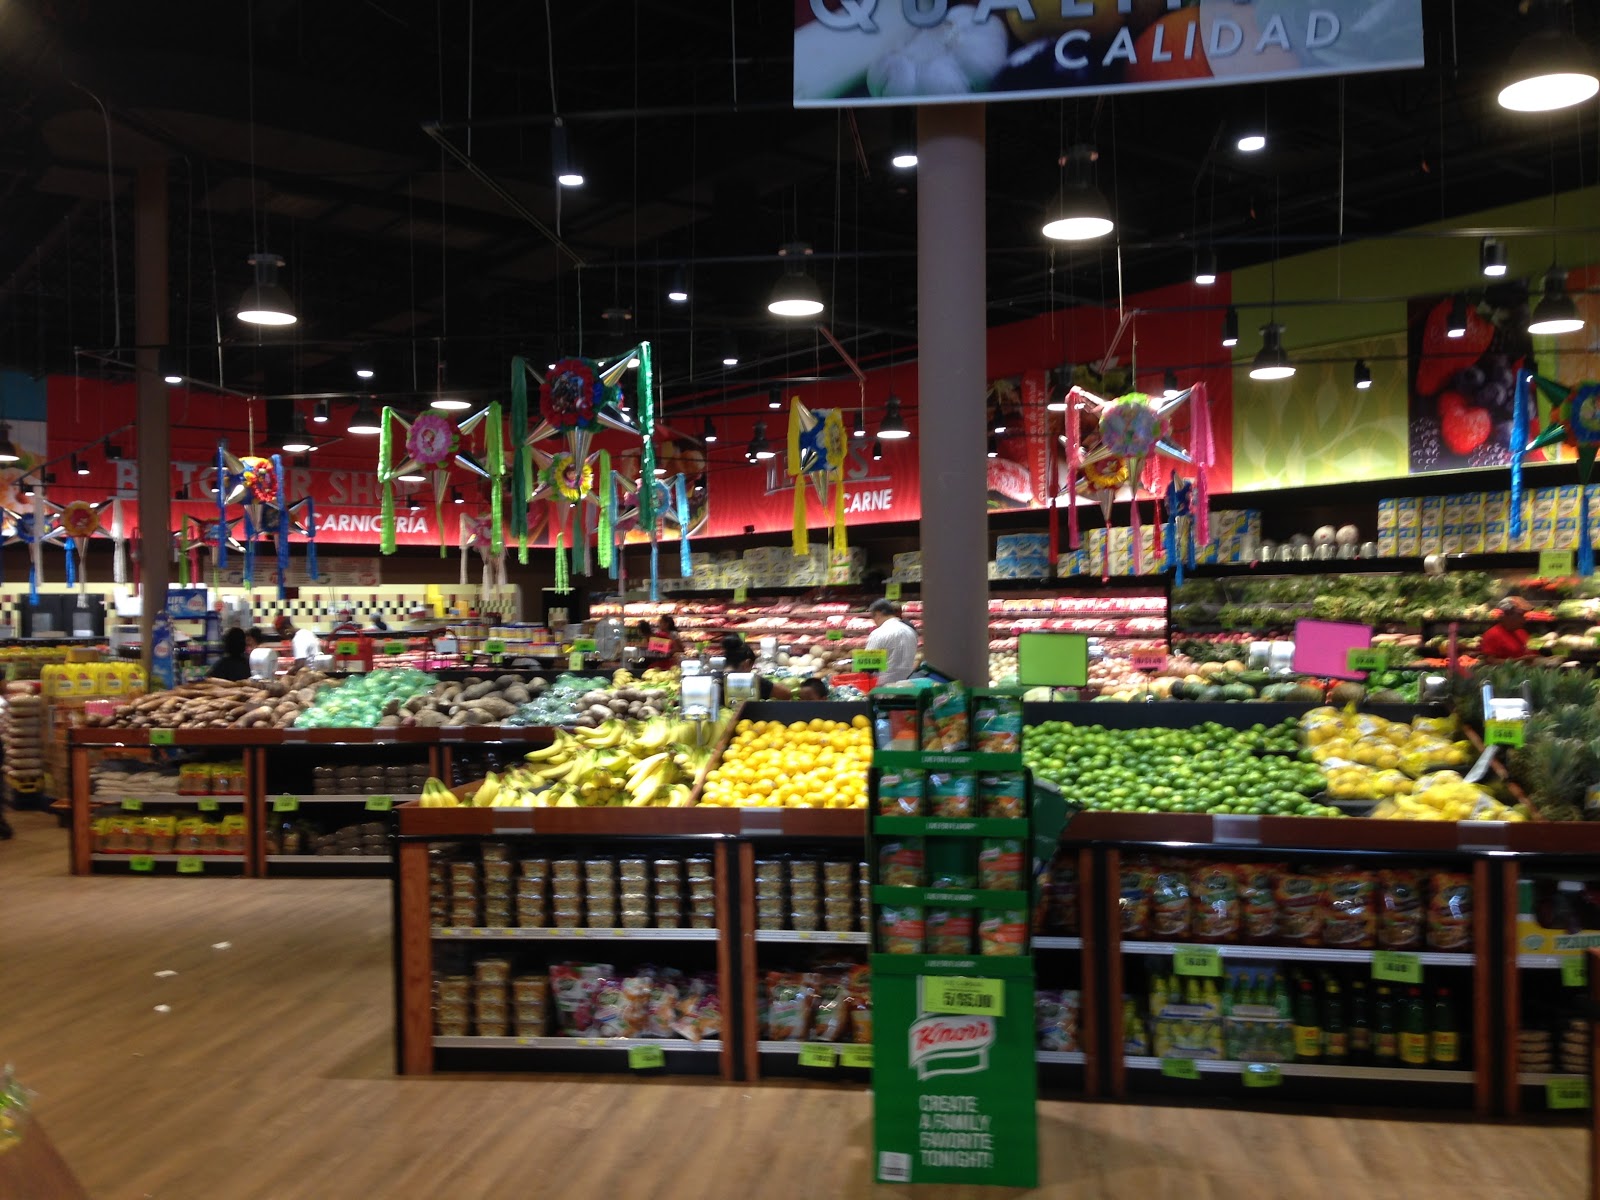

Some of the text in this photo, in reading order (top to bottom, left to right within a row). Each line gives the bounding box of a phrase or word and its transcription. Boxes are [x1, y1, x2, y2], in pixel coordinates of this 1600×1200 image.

[1053, 11, 1342, 70] CALIDAD
[843, 489, 893, 514] CARNE
[304, 510, 428, 534] CARNICRÍA
[919, 1095, 978, 1112] CREATE
[933, 1114, 992, 1131] FAMILY
[920, 1132, 995, 1150] FAVORITE
